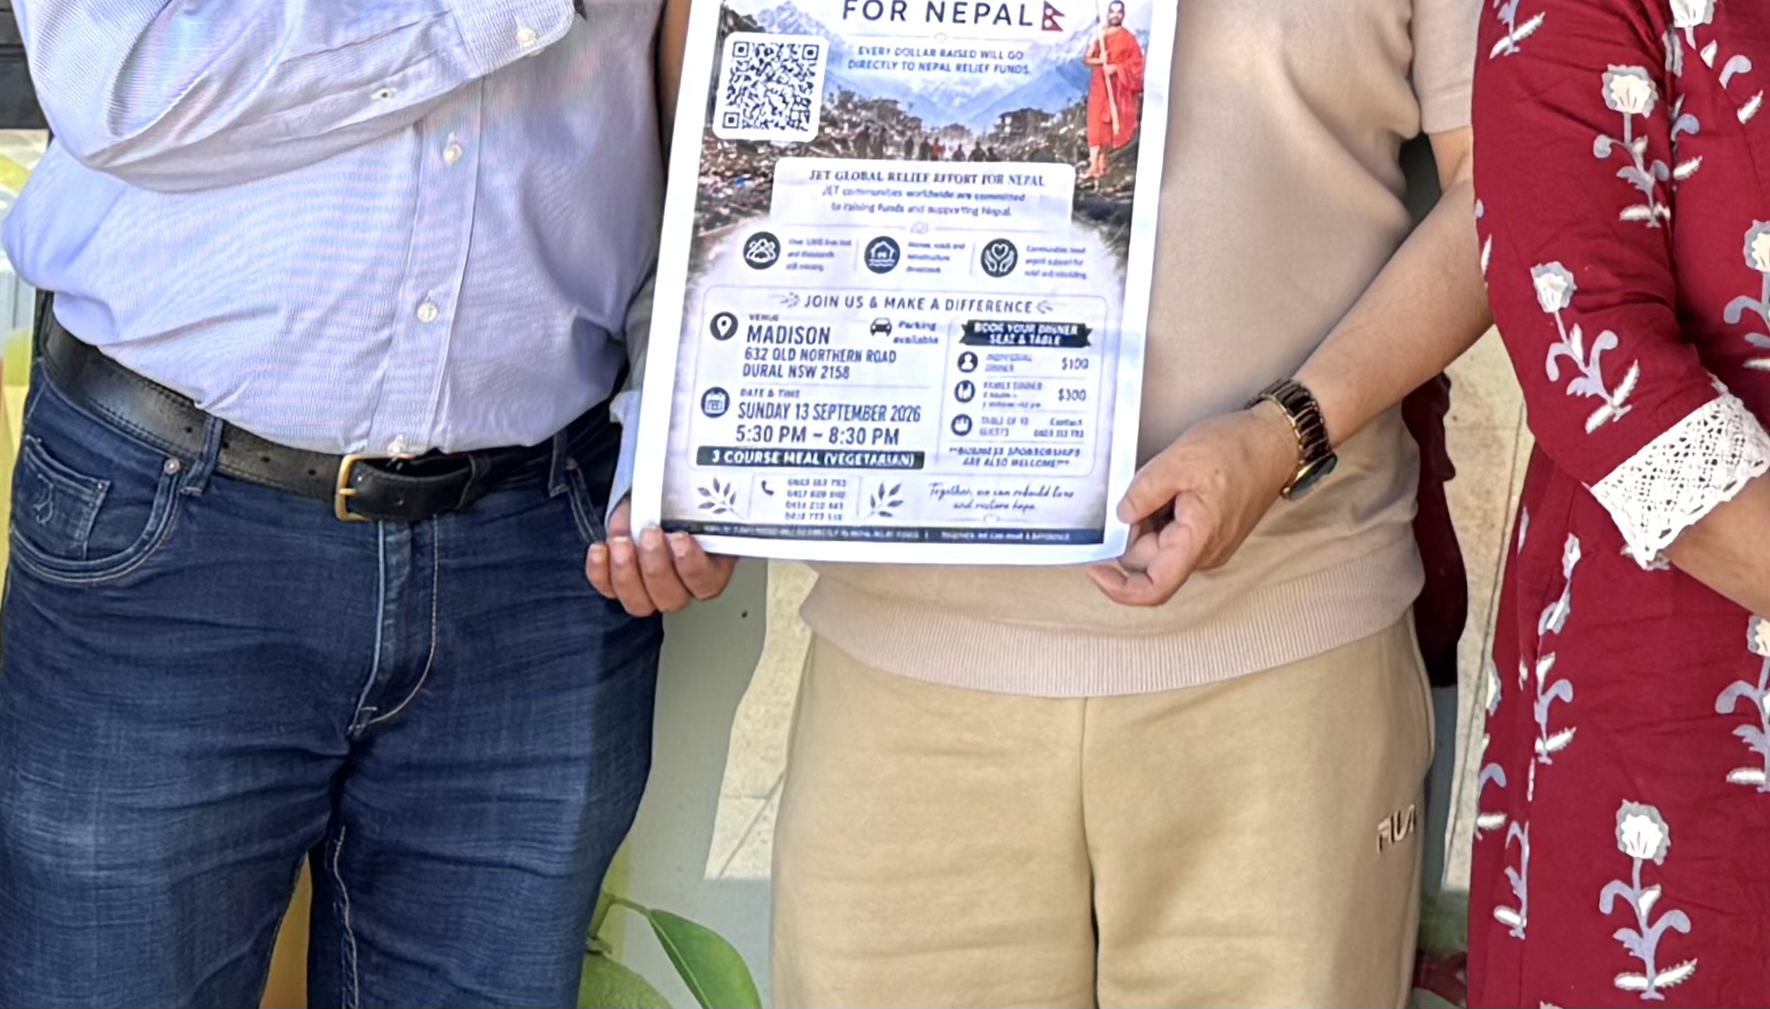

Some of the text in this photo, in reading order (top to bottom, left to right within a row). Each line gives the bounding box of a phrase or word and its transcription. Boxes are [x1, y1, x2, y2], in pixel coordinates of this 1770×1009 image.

[926, 1, 1034, 27] NEPAL
[858, 46, 1024, 60] EVERY DOLLAR RAISED WILL GO
[848, 59, 898, 71] DIRECTLY
[901, 62, 915, 72] TO
[918, 62, 952, 73] NEPAL
[956, 63, 991, 74] RELIEF
[809, 170, 1046, 187] JET GLOBAL RELIEF EFFORT FOR NEPAL
[804, 295, 1032, 313] JOIN US & MAKE A DIFFERENCE
[899, 320, 936, 331] Parking
[747, 325, 831, 345] MADISON
[744, 348, 897, 363] 632 OLD NORTHERN ROAD
[1062, 357, 1089, 370] $100
[743, 363, 850, 379] DURAL NSW 2158
[738, 402, 922, 422] SUNDAY 13 SEPTEMBER 2026
[736, 424, 773, 442] 5:30
[779, 425, 807, 443] PM
[829, 426, 866, 444] 8:30
[871, 428, 899, 445] PM
[712, 449, 914, 467] 3 COURSE MEAL (VEGETARIAN)
